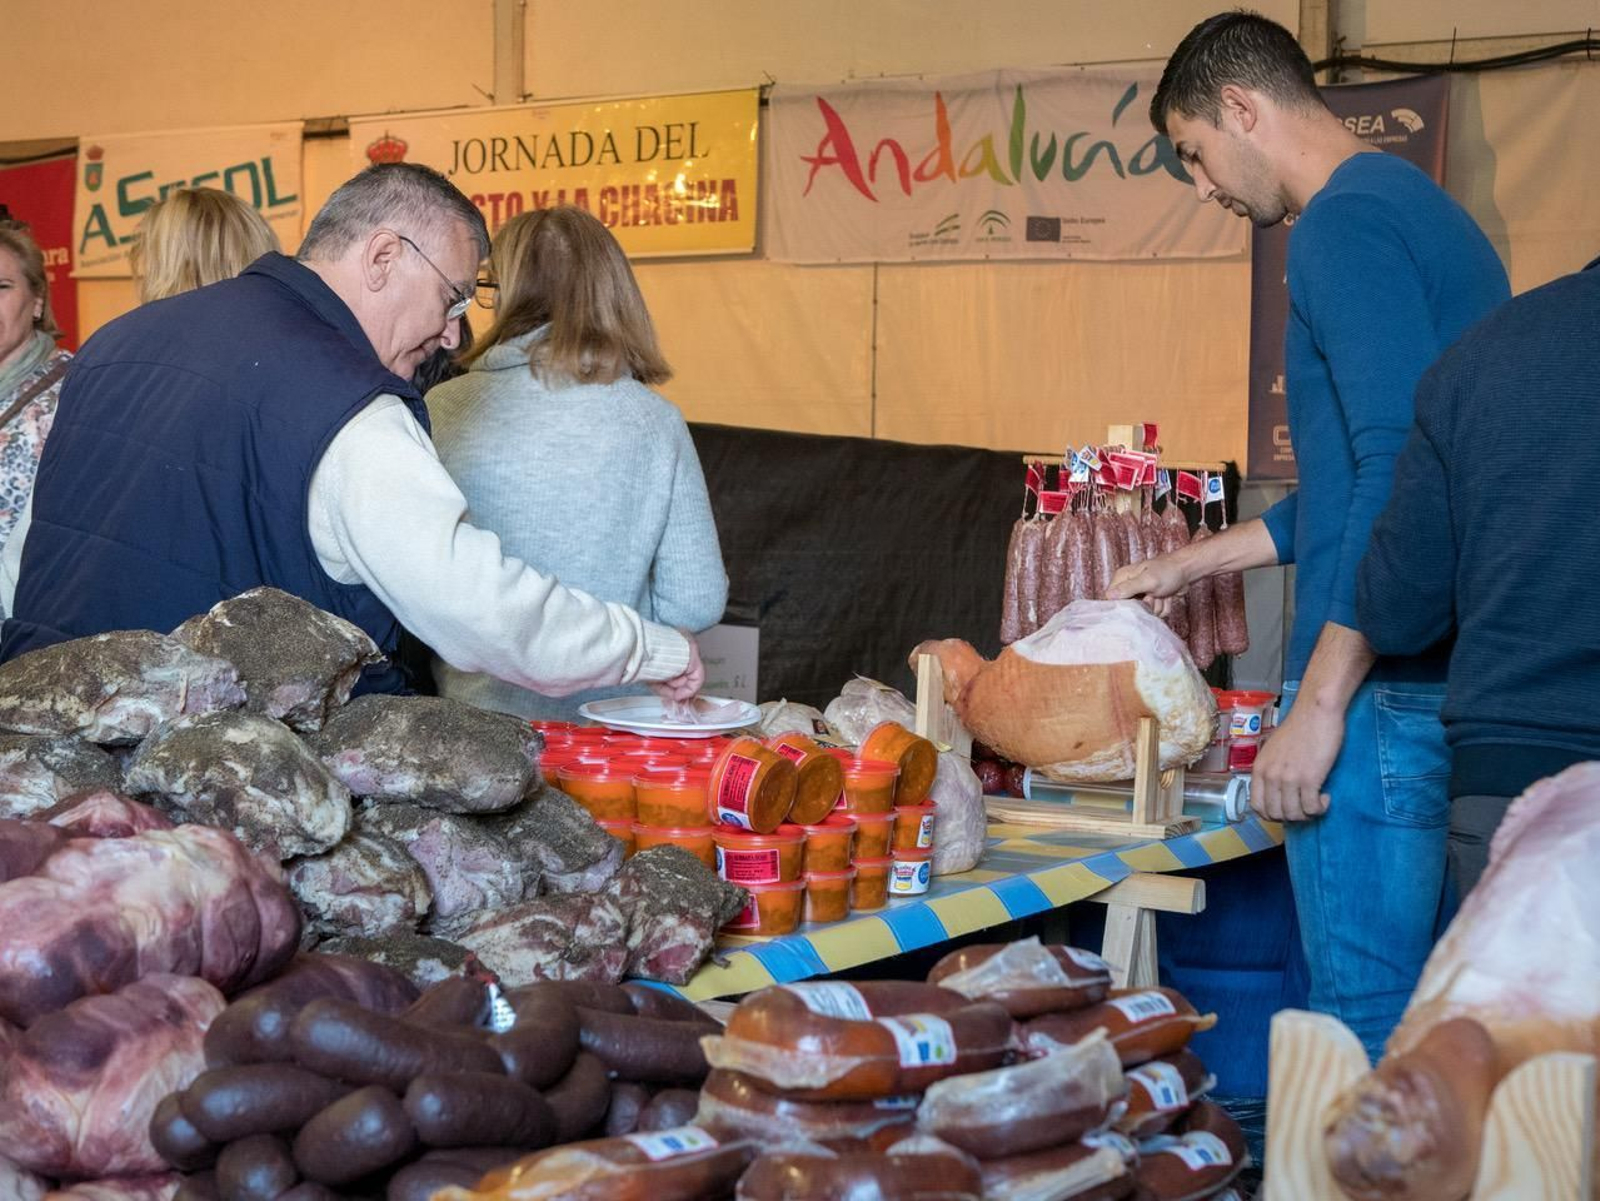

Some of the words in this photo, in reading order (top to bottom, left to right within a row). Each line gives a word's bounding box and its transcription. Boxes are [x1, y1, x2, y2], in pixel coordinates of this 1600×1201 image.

[448, 131, 621, 176] JORNADA
[635, 121, 710, 163] DEL
[800, 82, 1194, 203] Andalucía
[1336, 114, 1386, 136] SEA
